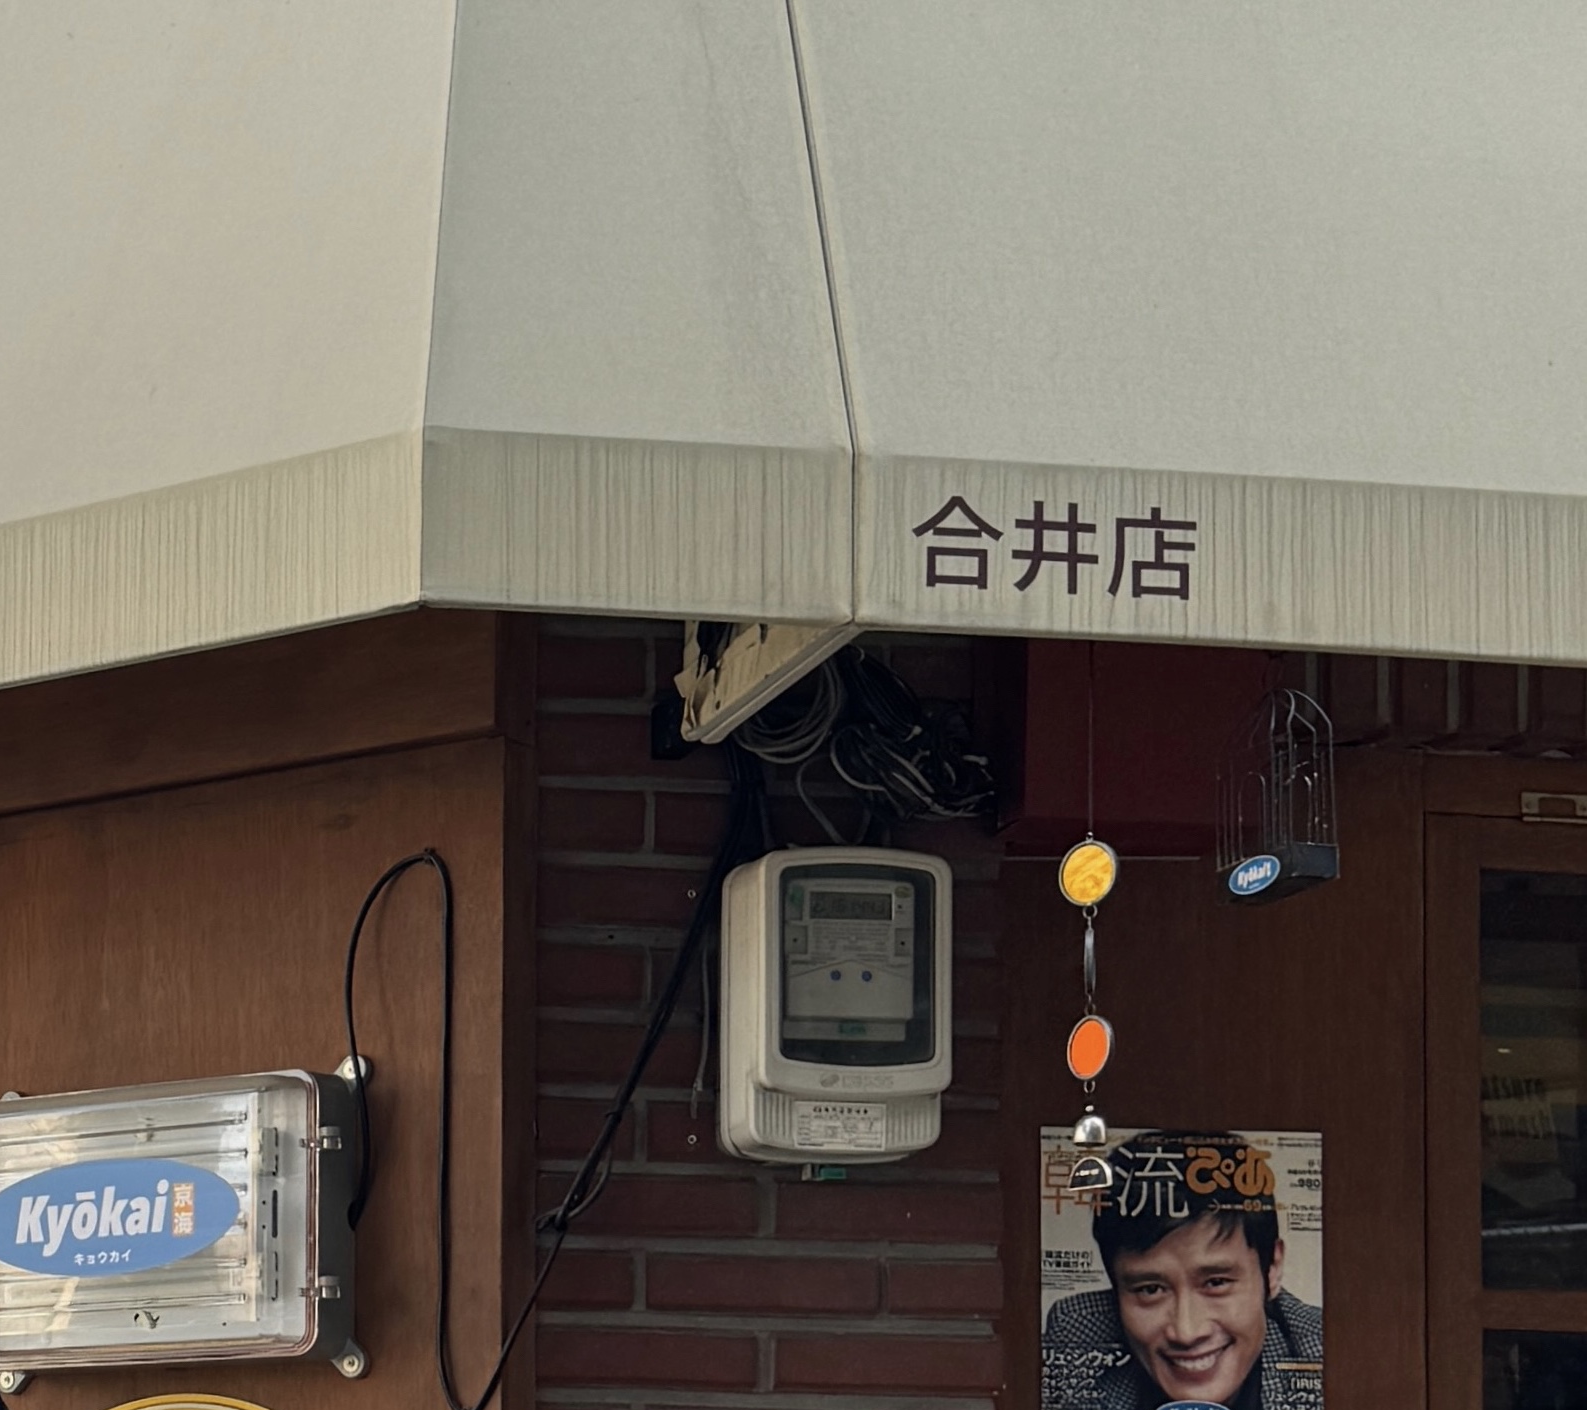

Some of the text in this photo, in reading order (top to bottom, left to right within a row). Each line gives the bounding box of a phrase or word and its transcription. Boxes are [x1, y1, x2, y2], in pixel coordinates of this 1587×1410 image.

[912, 495, 1198, 600] 合井店
[16, 1179, 171, 1257] Kyōkai
[172, 1182, 195, 1236] 京海
[74, 1249, 131, 1266] キョウカイ
